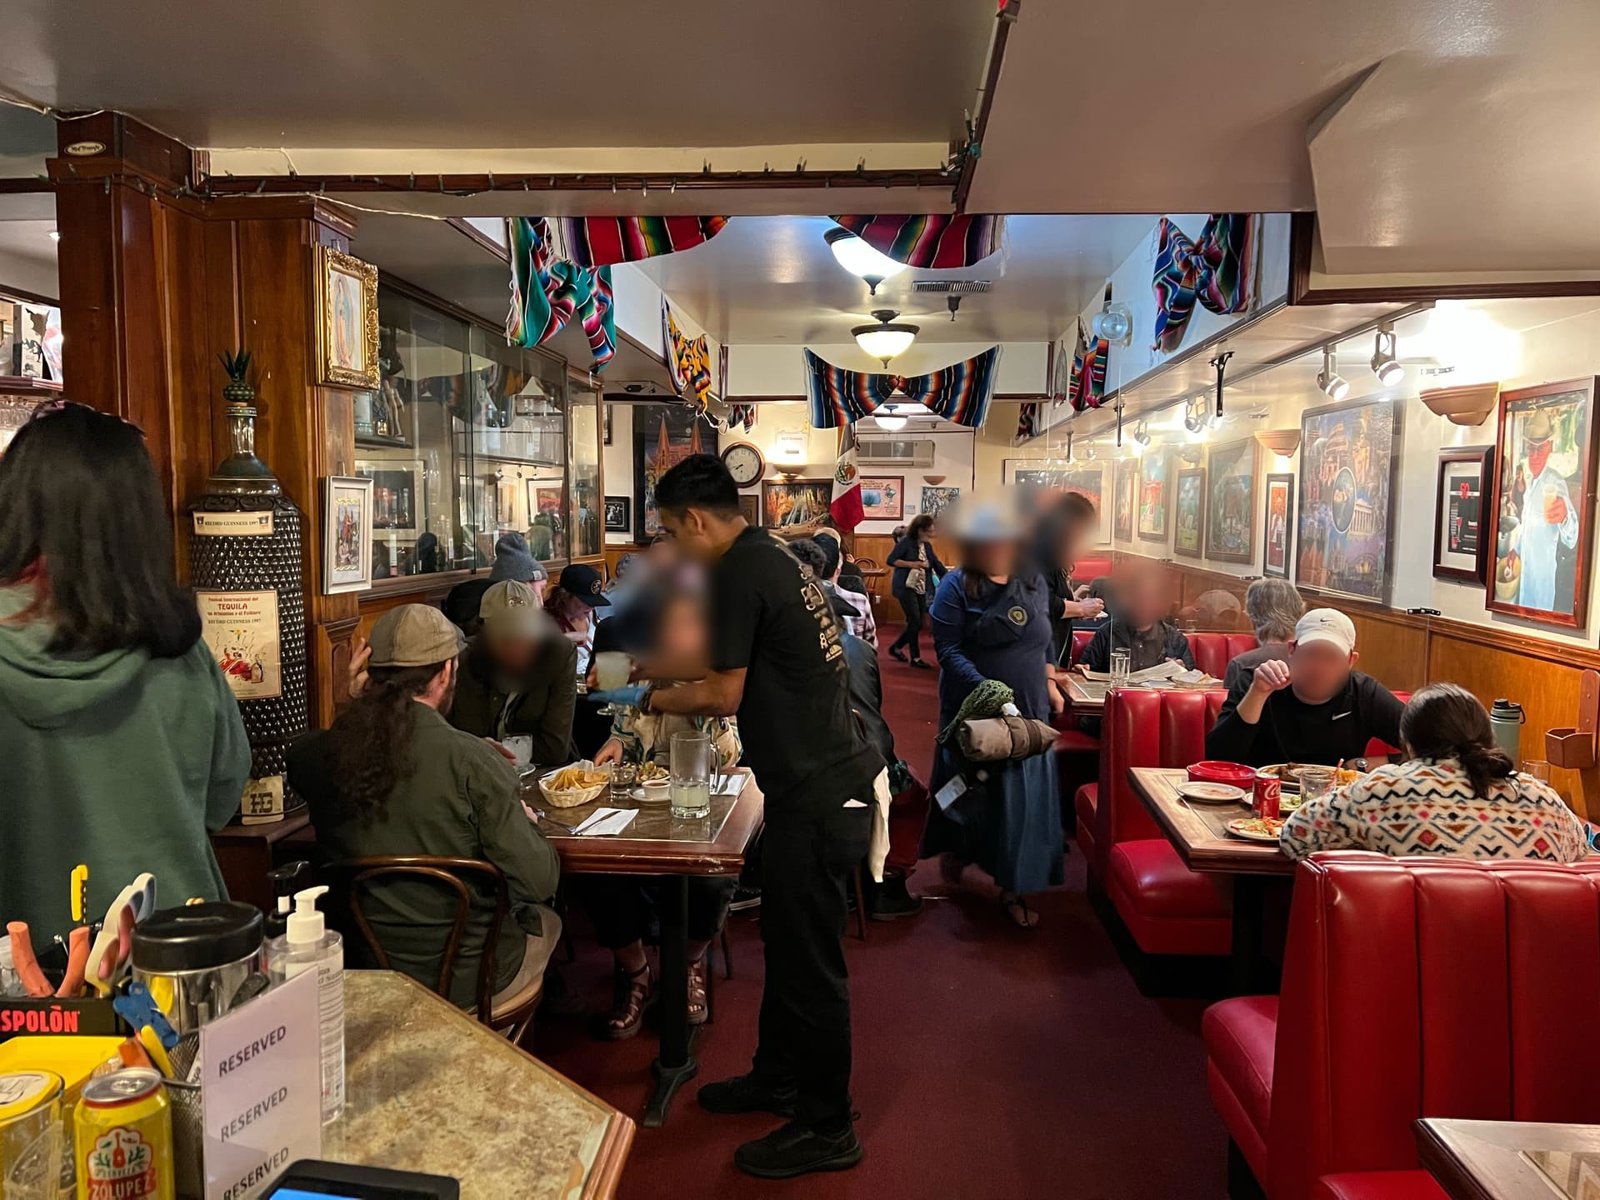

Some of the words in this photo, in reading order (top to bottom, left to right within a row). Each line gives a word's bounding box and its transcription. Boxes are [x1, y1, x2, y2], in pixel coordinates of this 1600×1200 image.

[0, 1005, 79, 1033] SPOLÓN
[218, 1025, 287, 1078] RESERVED
[220, 1086, 288, 1143] RESERVED
[223, 1147, 289, 1200] RESERVED
